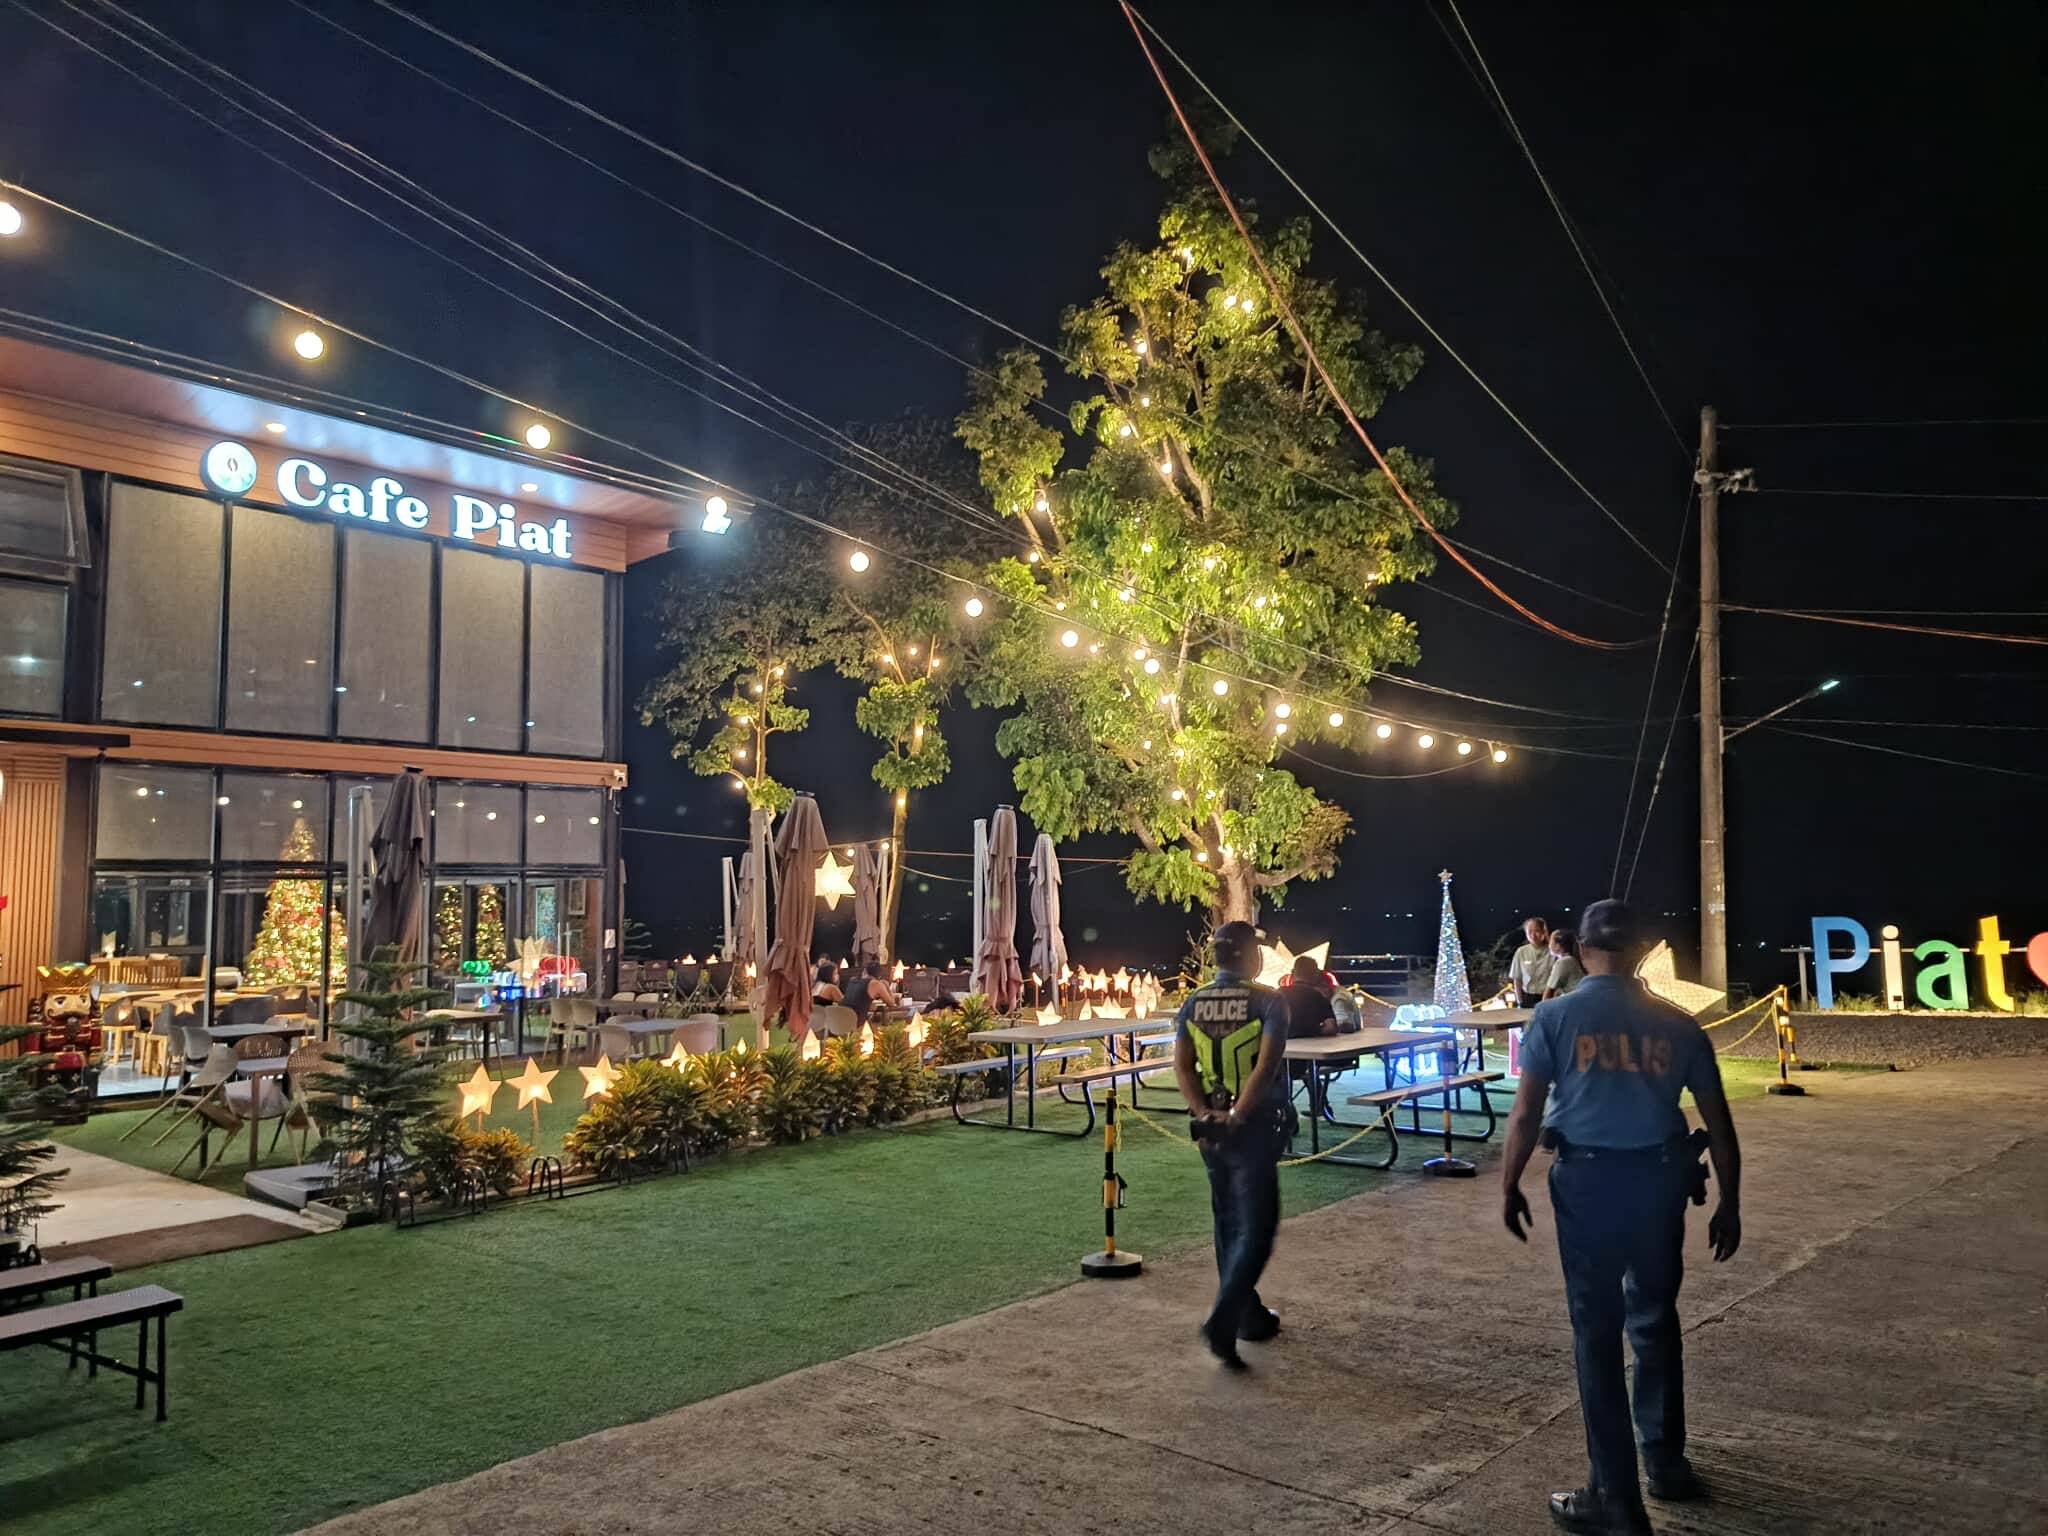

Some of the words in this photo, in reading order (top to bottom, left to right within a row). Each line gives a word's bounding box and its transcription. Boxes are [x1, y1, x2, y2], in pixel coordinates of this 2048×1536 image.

[277, 458, 430, 529] Cafe
[452, 494, 572, 559] Piat
[1194, 999, 1249, 1022] POLICE
[1811, 915, 2015, 1012] Piat
